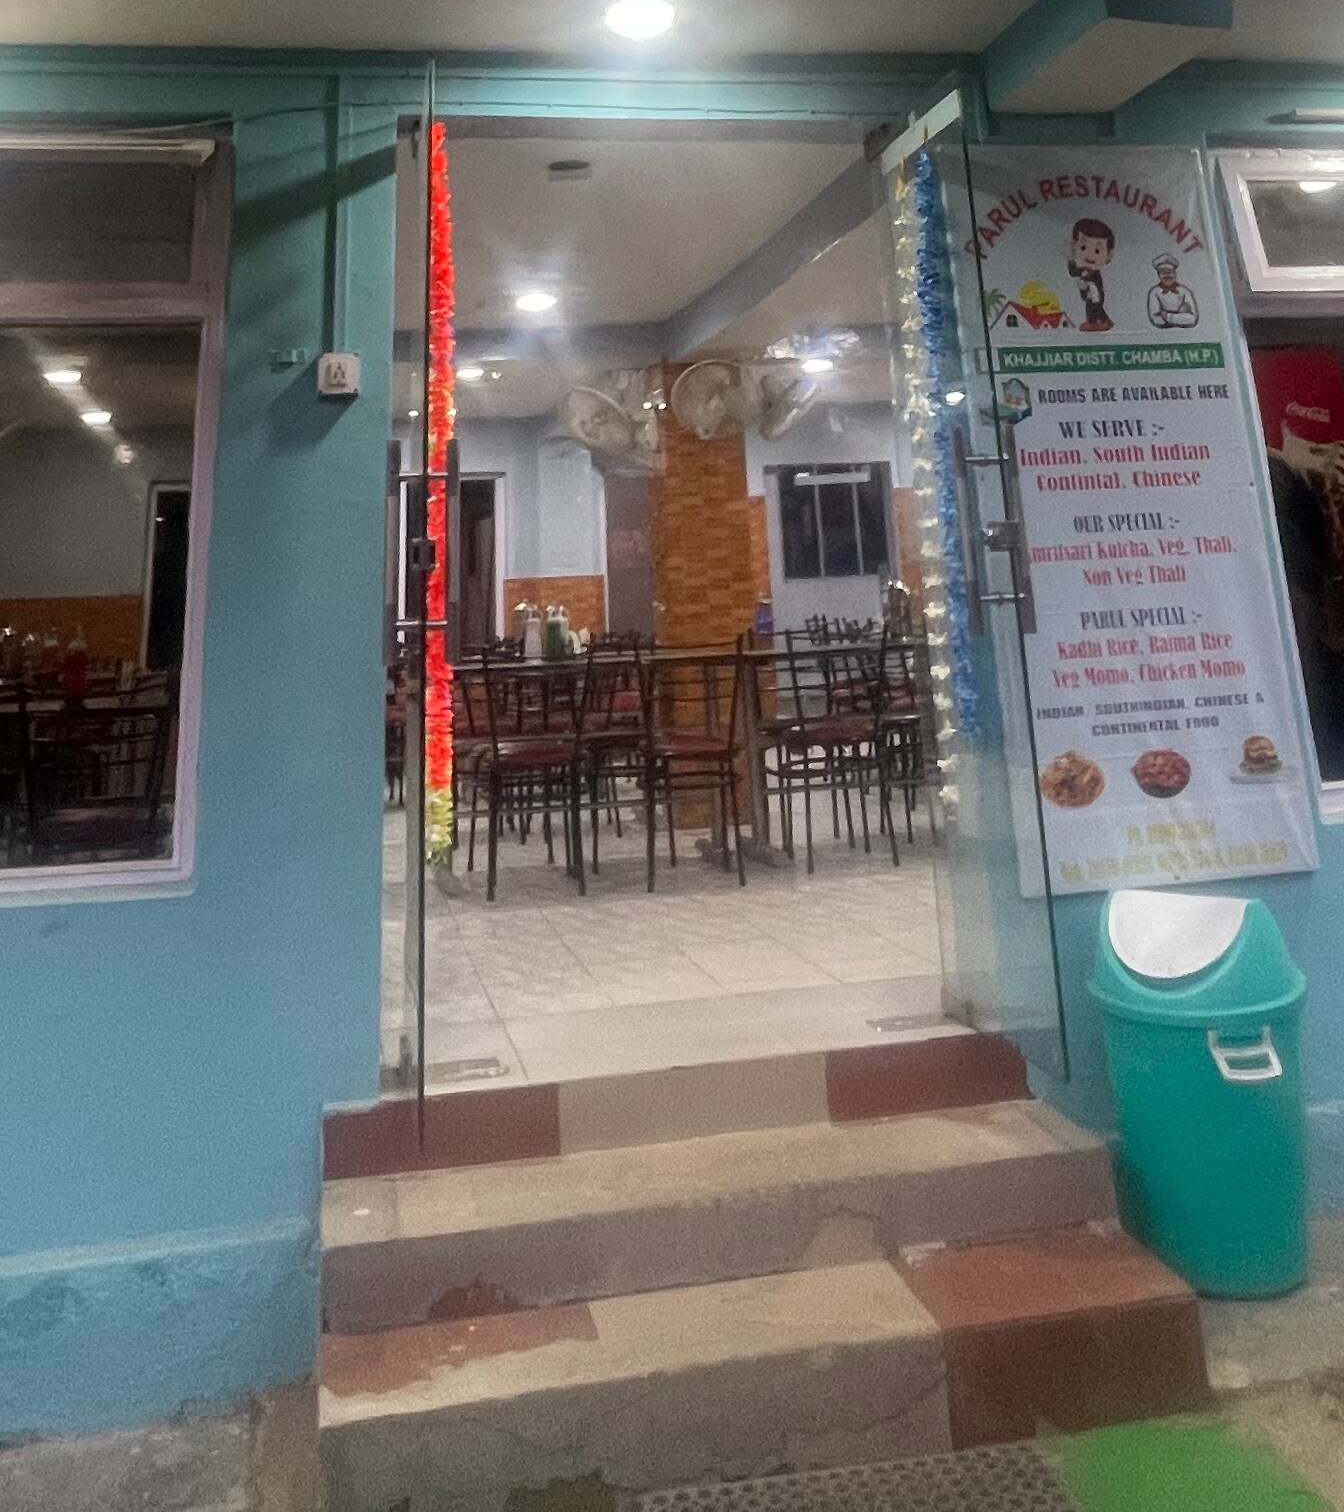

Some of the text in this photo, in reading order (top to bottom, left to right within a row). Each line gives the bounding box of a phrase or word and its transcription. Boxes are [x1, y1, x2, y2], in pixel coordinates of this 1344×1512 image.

[963, 174, 1204, 260] PARUL RESTAURANT
[1004, 351, 1073, 368] KHAJJIAR
[1122, 349, 1184, 365] CHAMBA
[1038, 384, 1231, 404] ROOMS ARE AVAILABLE HERE
[1059, 420, 1086, 439] WE
[1091, 419, 1145, 438] SERVE
[1093, 444, 1145, 464] South
[1151, 443, 1211, 462] Indian
[1132, 469, 1202, 489] Chinese
[1073, 515, 1104, 533] OUR
[1108, 512, 1164, 532] SPECIAL
[1029, 543, 1092, 564] mritsari
[1082, 568, 1112, 586] Non
[1148, 564, 1187, 583] Thali
[1080, 610, 1127, 630] PARUL
[1130, 606, 1186, 627] SPECIAL
[1057, 638, 1103, 660] Kadhi
[1149, 633, 1197, 655] Rajma
[1200, 631, 1233, 650] Rice
[1052, 668, 1080, 689] Veg
[1138, 661, 1197, 683] Chicken
[1200, 658, 1246, 679] Momo
[1194, 693, 1249, 708] CHINESE
[1092, 715, 1220, 737] CONTINENTAL FOOD
